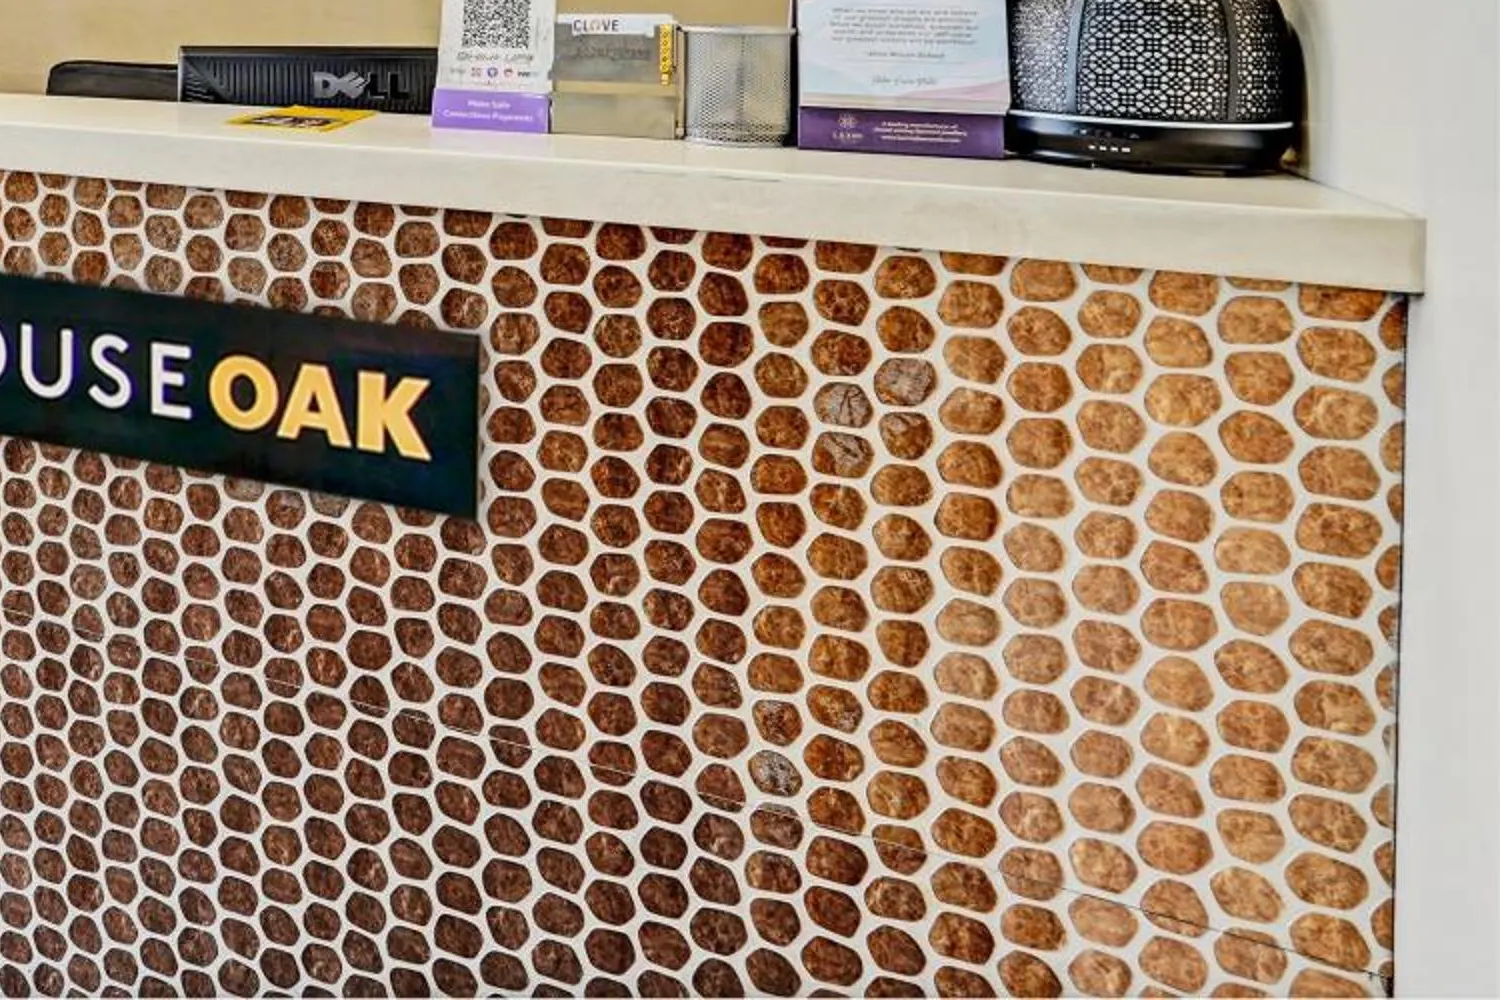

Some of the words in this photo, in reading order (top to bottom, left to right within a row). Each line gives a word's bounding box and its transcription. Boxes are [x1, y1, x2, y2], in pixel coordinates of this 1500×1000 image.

[573, 19, 619, 32] CLOVE
[314, 71, 409, 99] DELL
[209, 354, 432, 461] OAK
